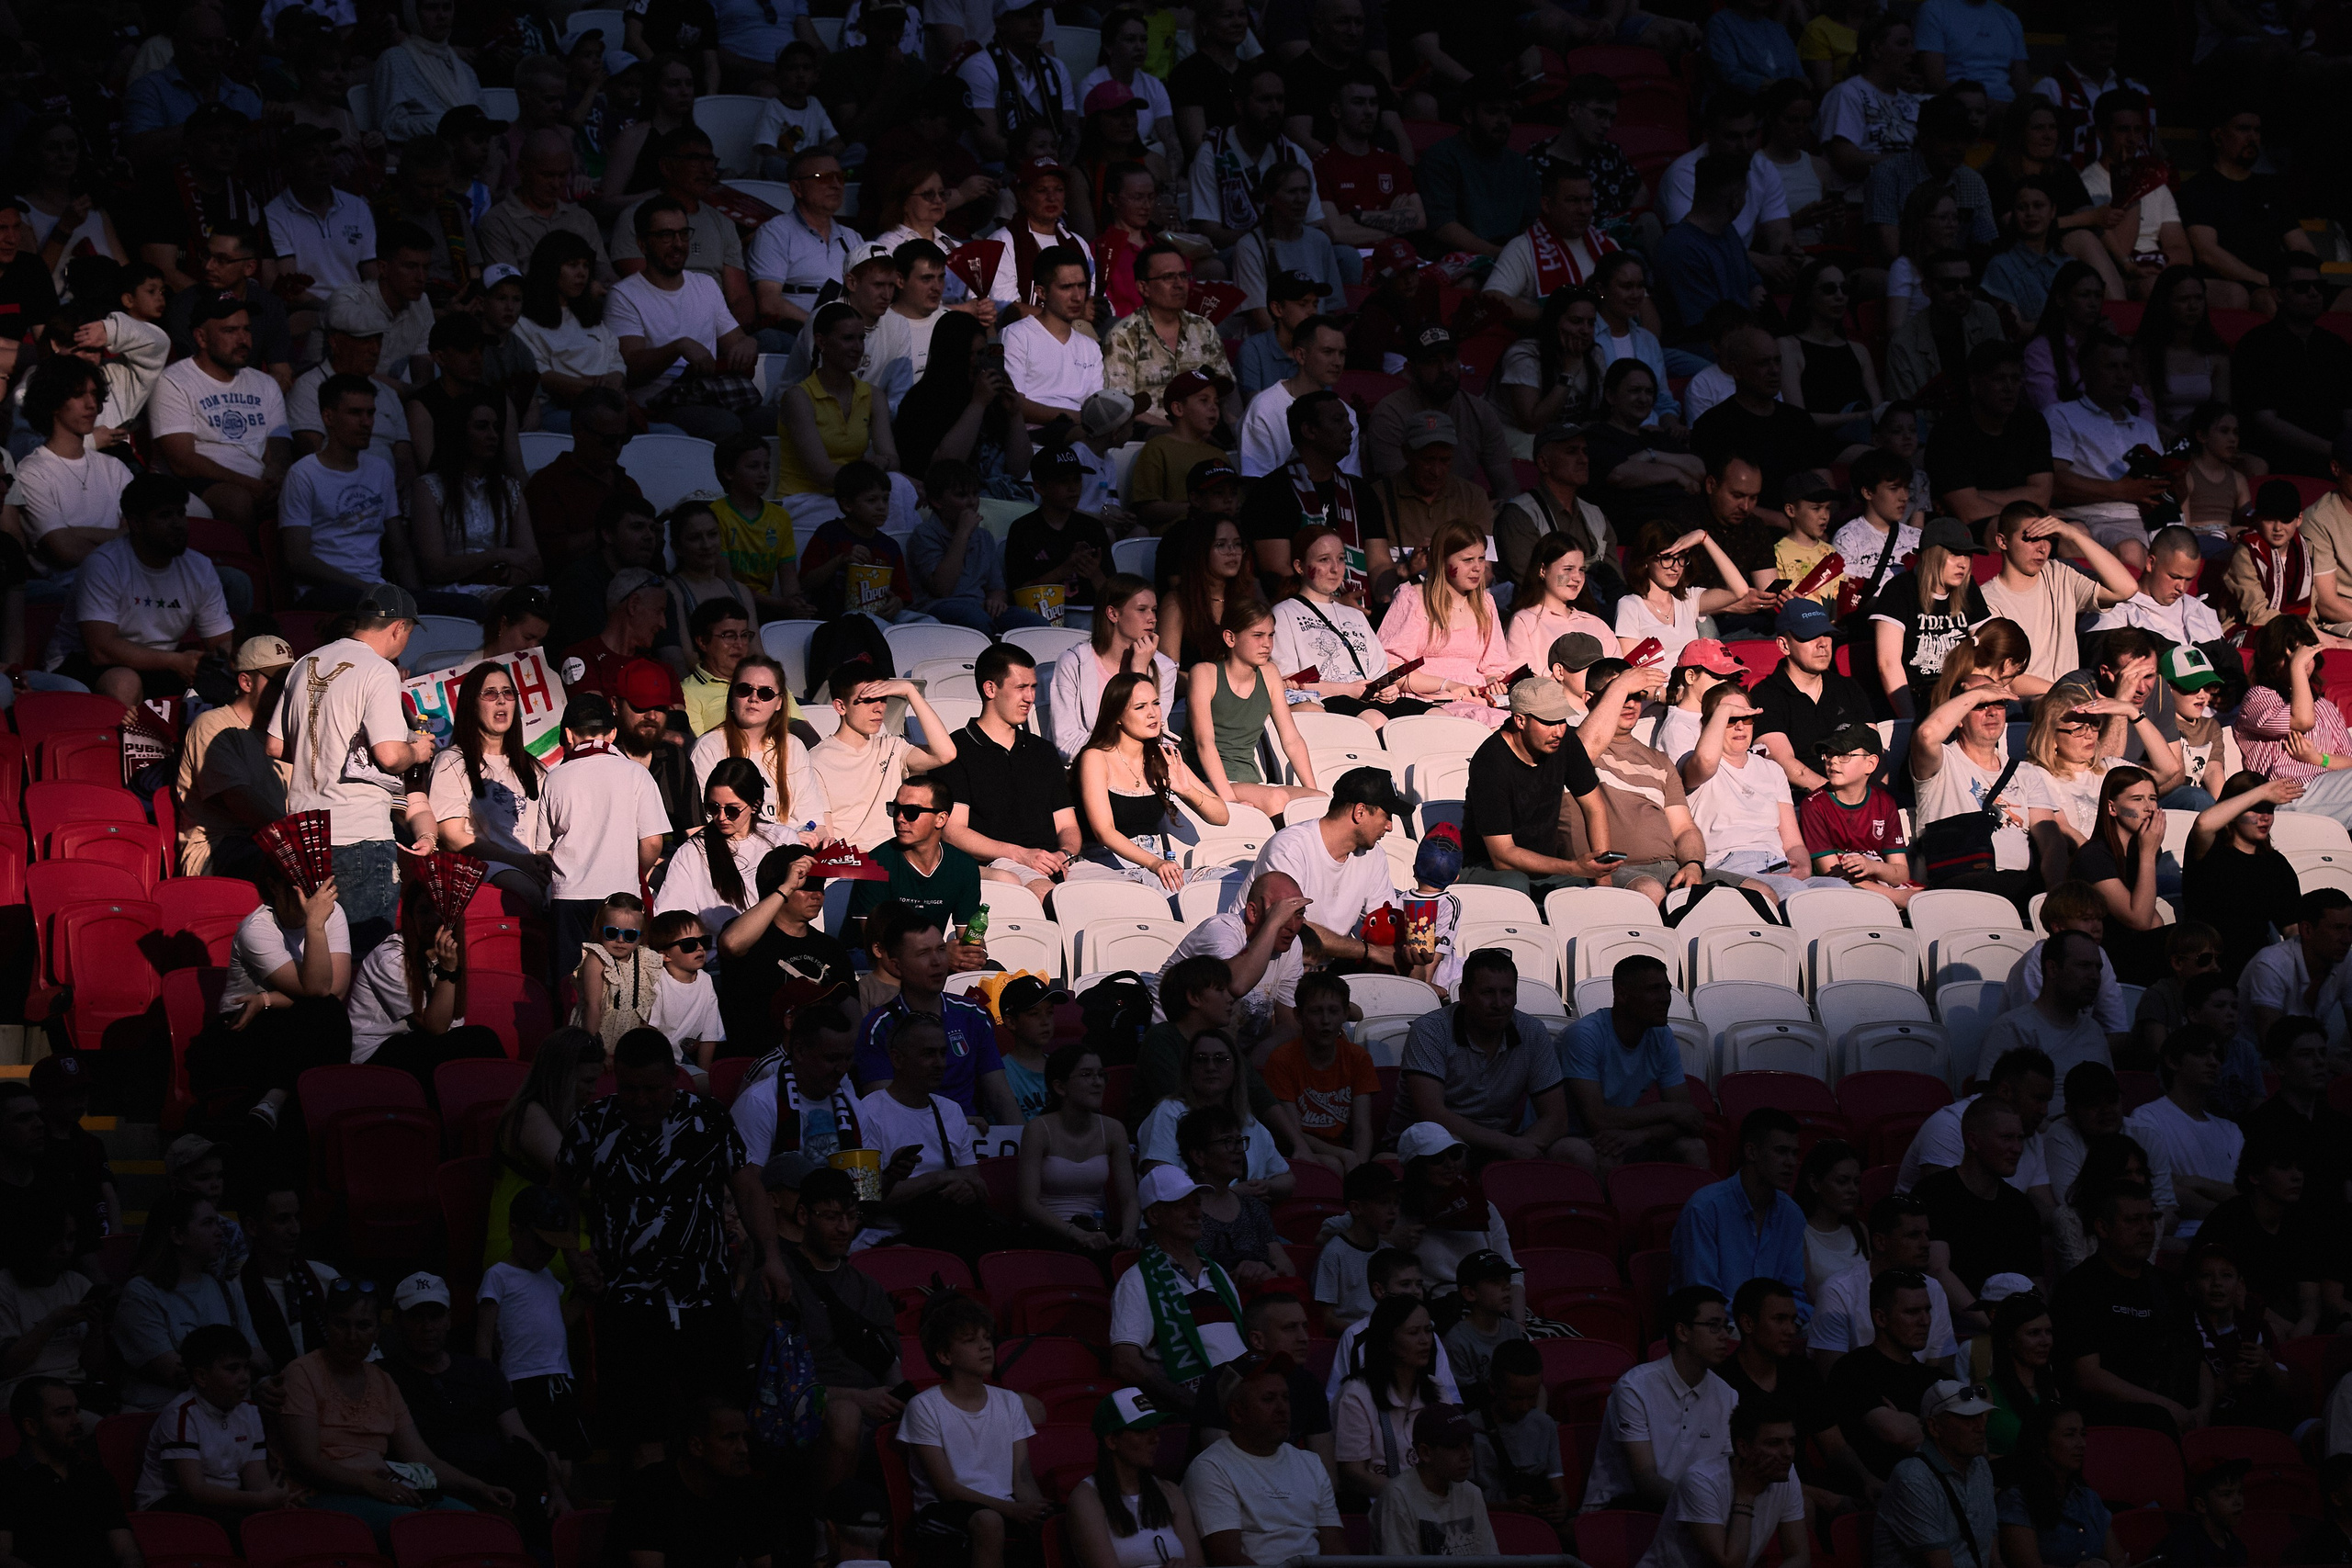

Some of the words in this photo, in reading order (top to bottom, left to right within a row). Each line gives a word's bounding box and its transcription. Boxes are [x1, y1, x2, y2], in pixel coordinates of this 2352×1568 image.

[199, 395, 221, 411] TOM
[248, 413, 266, 427] 62
[2112, 1304, 2154, 1318] carhar
